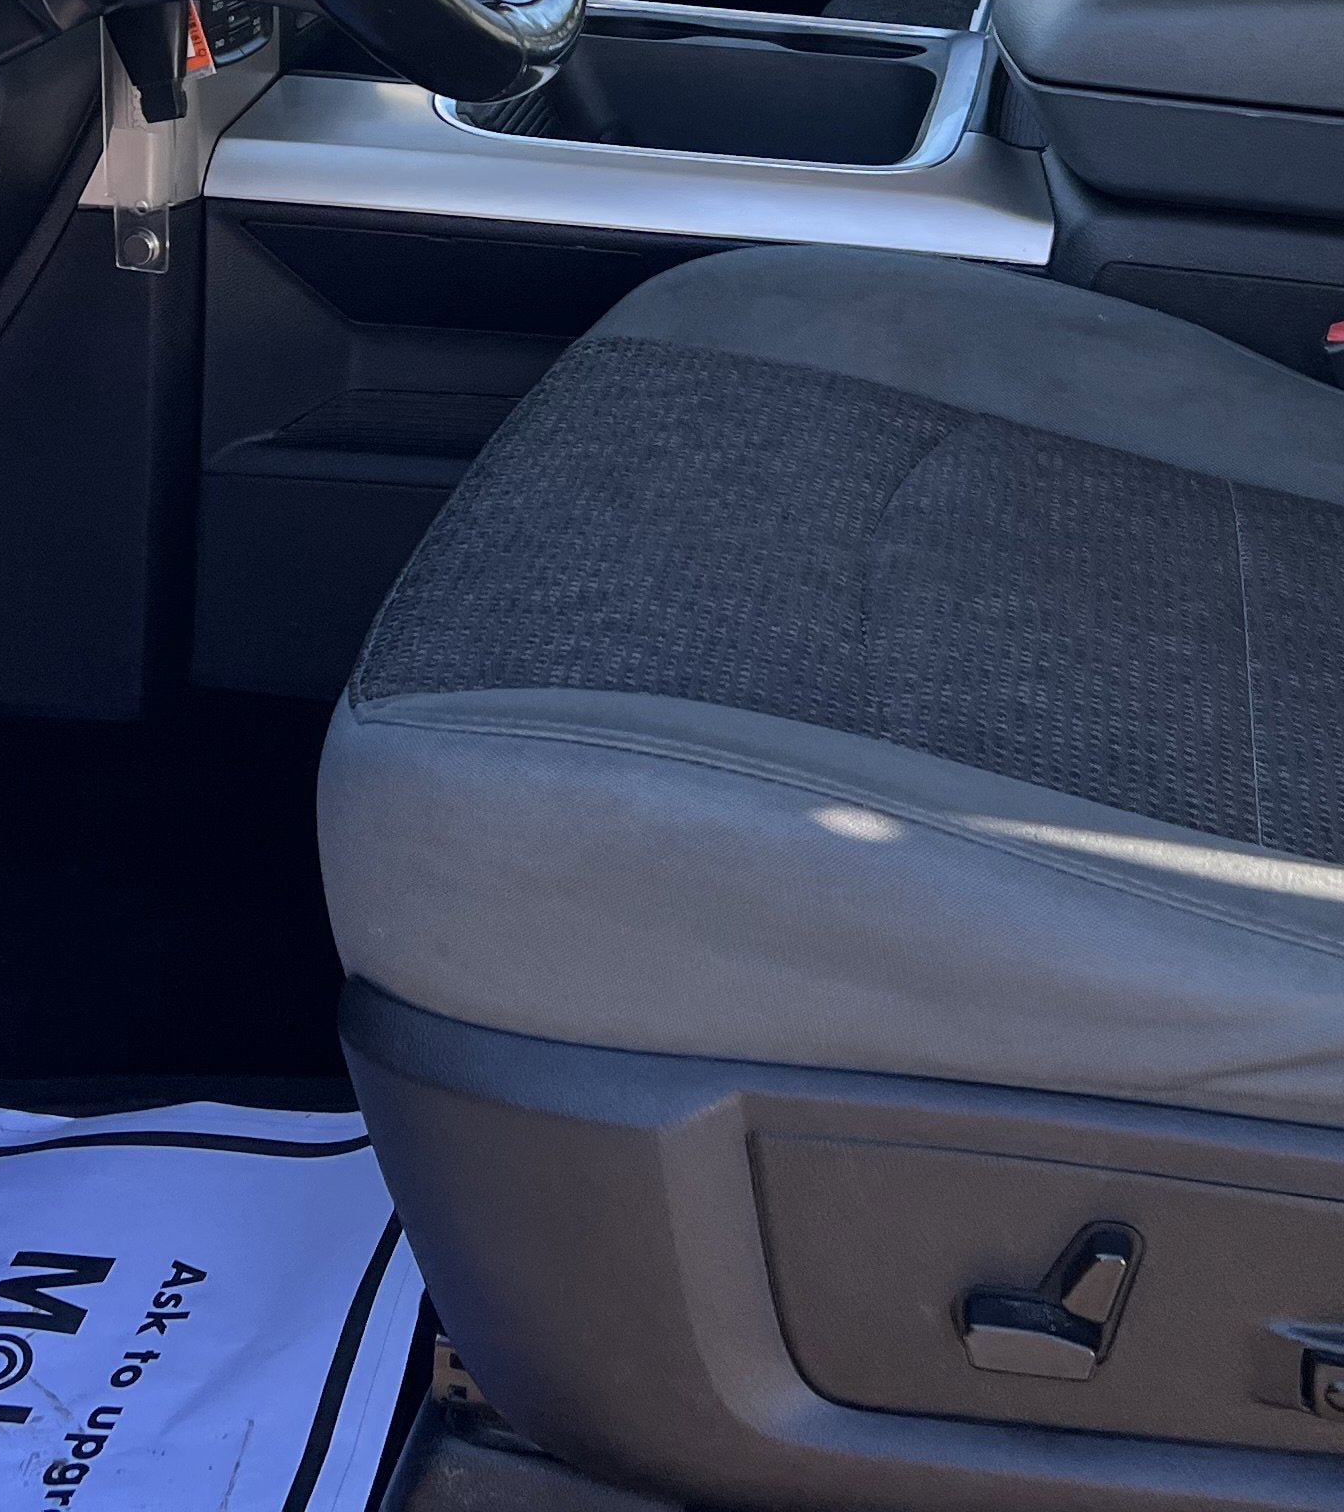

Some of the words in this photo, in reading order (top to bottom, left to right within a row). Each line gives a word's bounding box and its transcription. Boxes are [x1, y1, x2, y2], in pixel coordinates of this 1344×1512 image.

[135, 1259, 208, 1336] Ask
[109, 1349, 161, 1388] to
[42, 1406, 124, 1512] upgr
